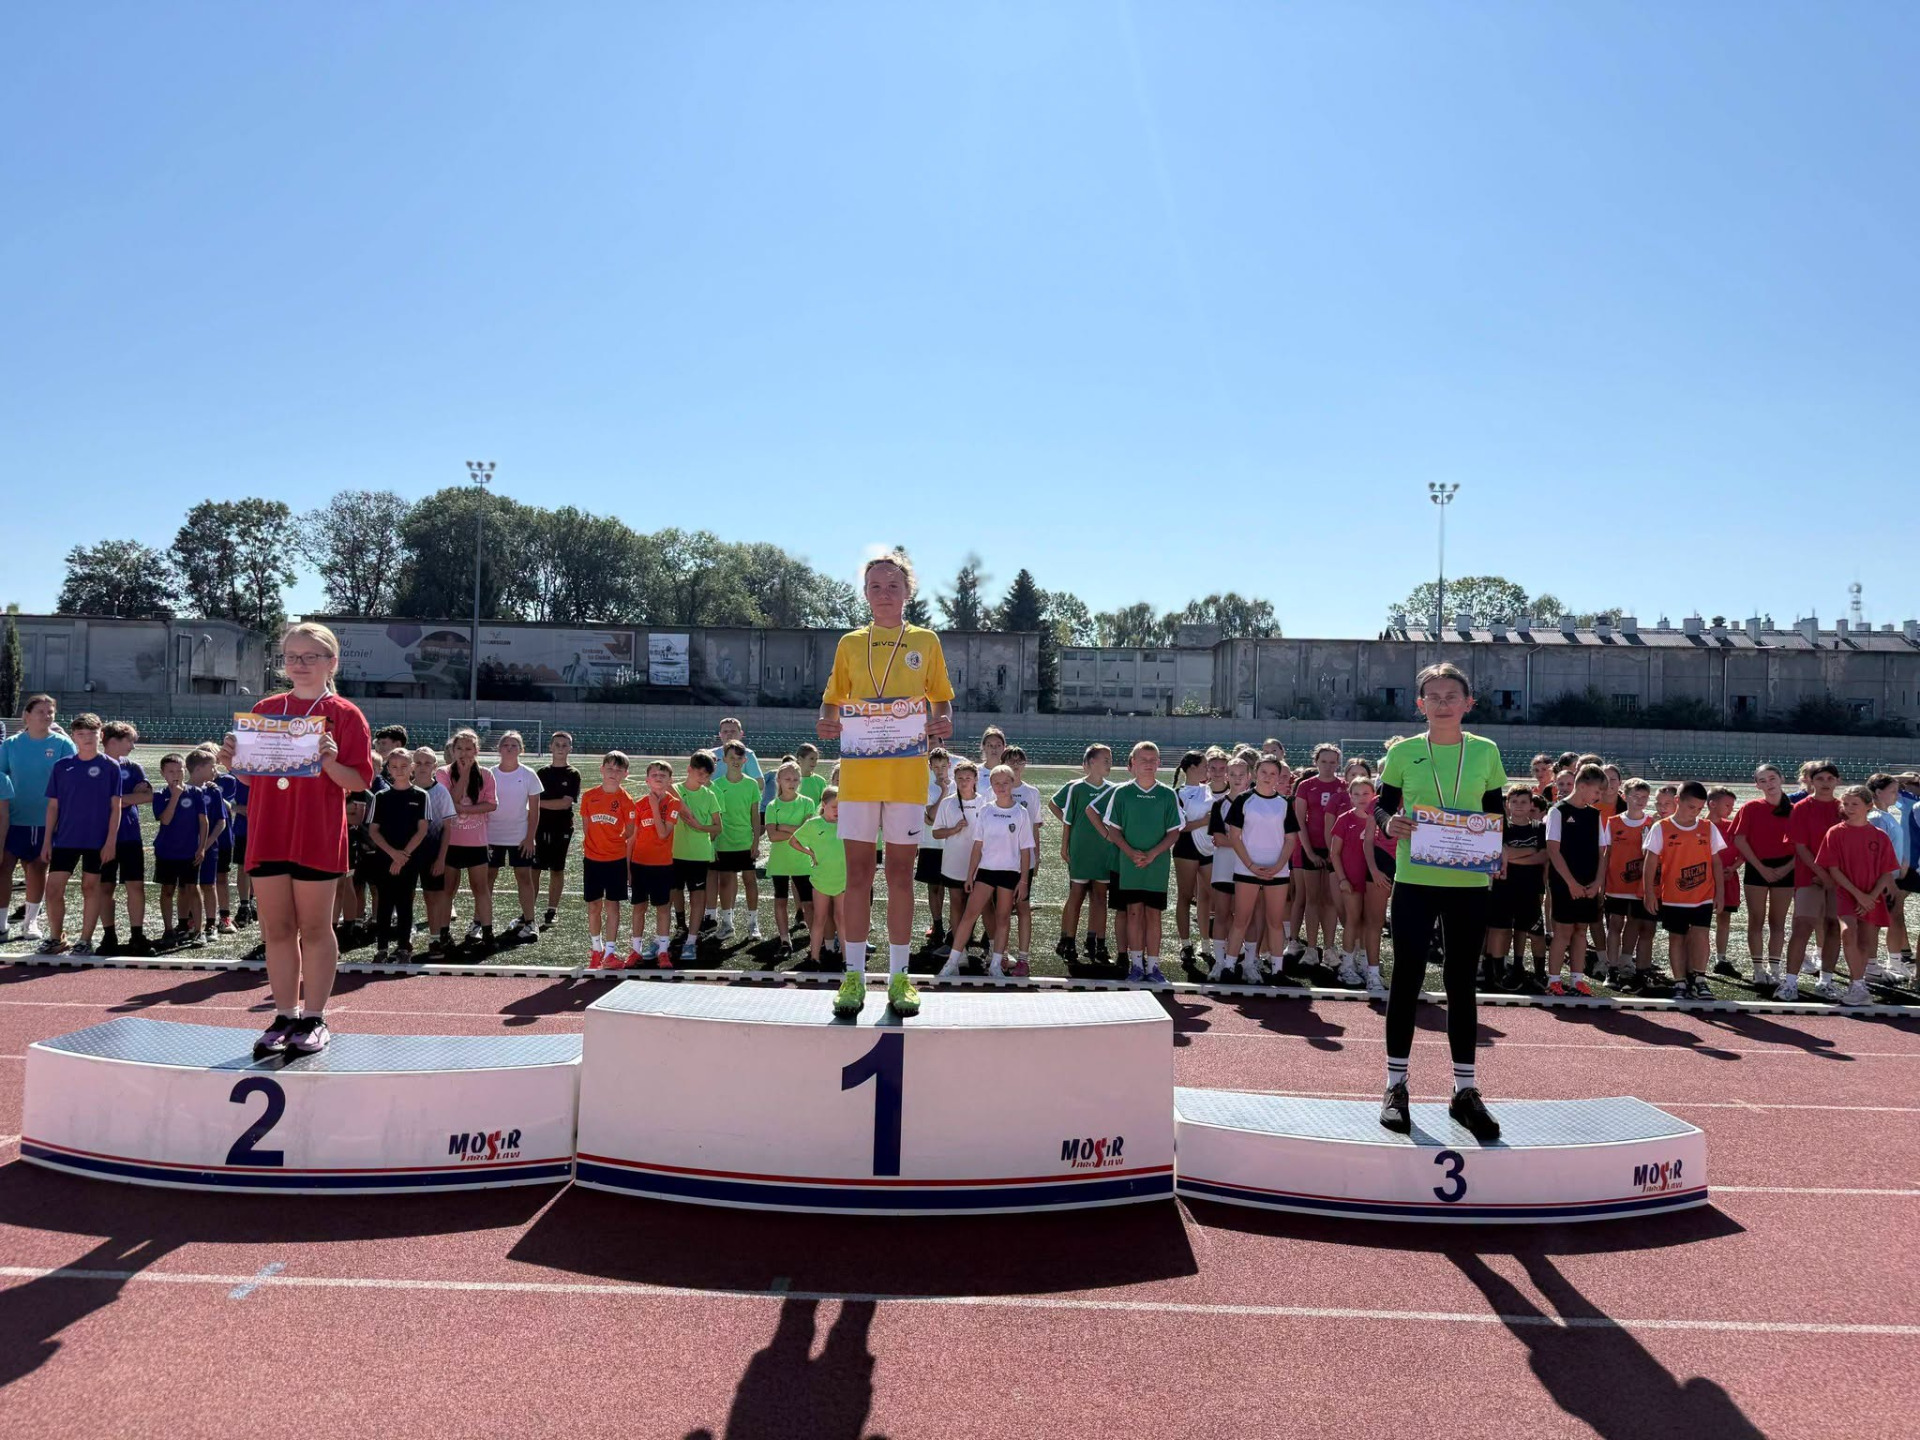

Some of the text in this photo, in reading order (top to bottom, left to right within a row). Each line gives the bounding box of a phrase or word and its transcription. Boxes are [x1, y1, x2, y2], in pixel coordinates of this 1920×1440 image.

[237, 717, 323, 736] DYPLOM
[842, 700, 924, 719] DYPLOM
[1416, 809, 1501, 832] DYPLOM
[225, 1076, 286, 1167] 2
[841, 1033, 904, 1176] 1
[1433, 1150, 1467, 1203] 3
